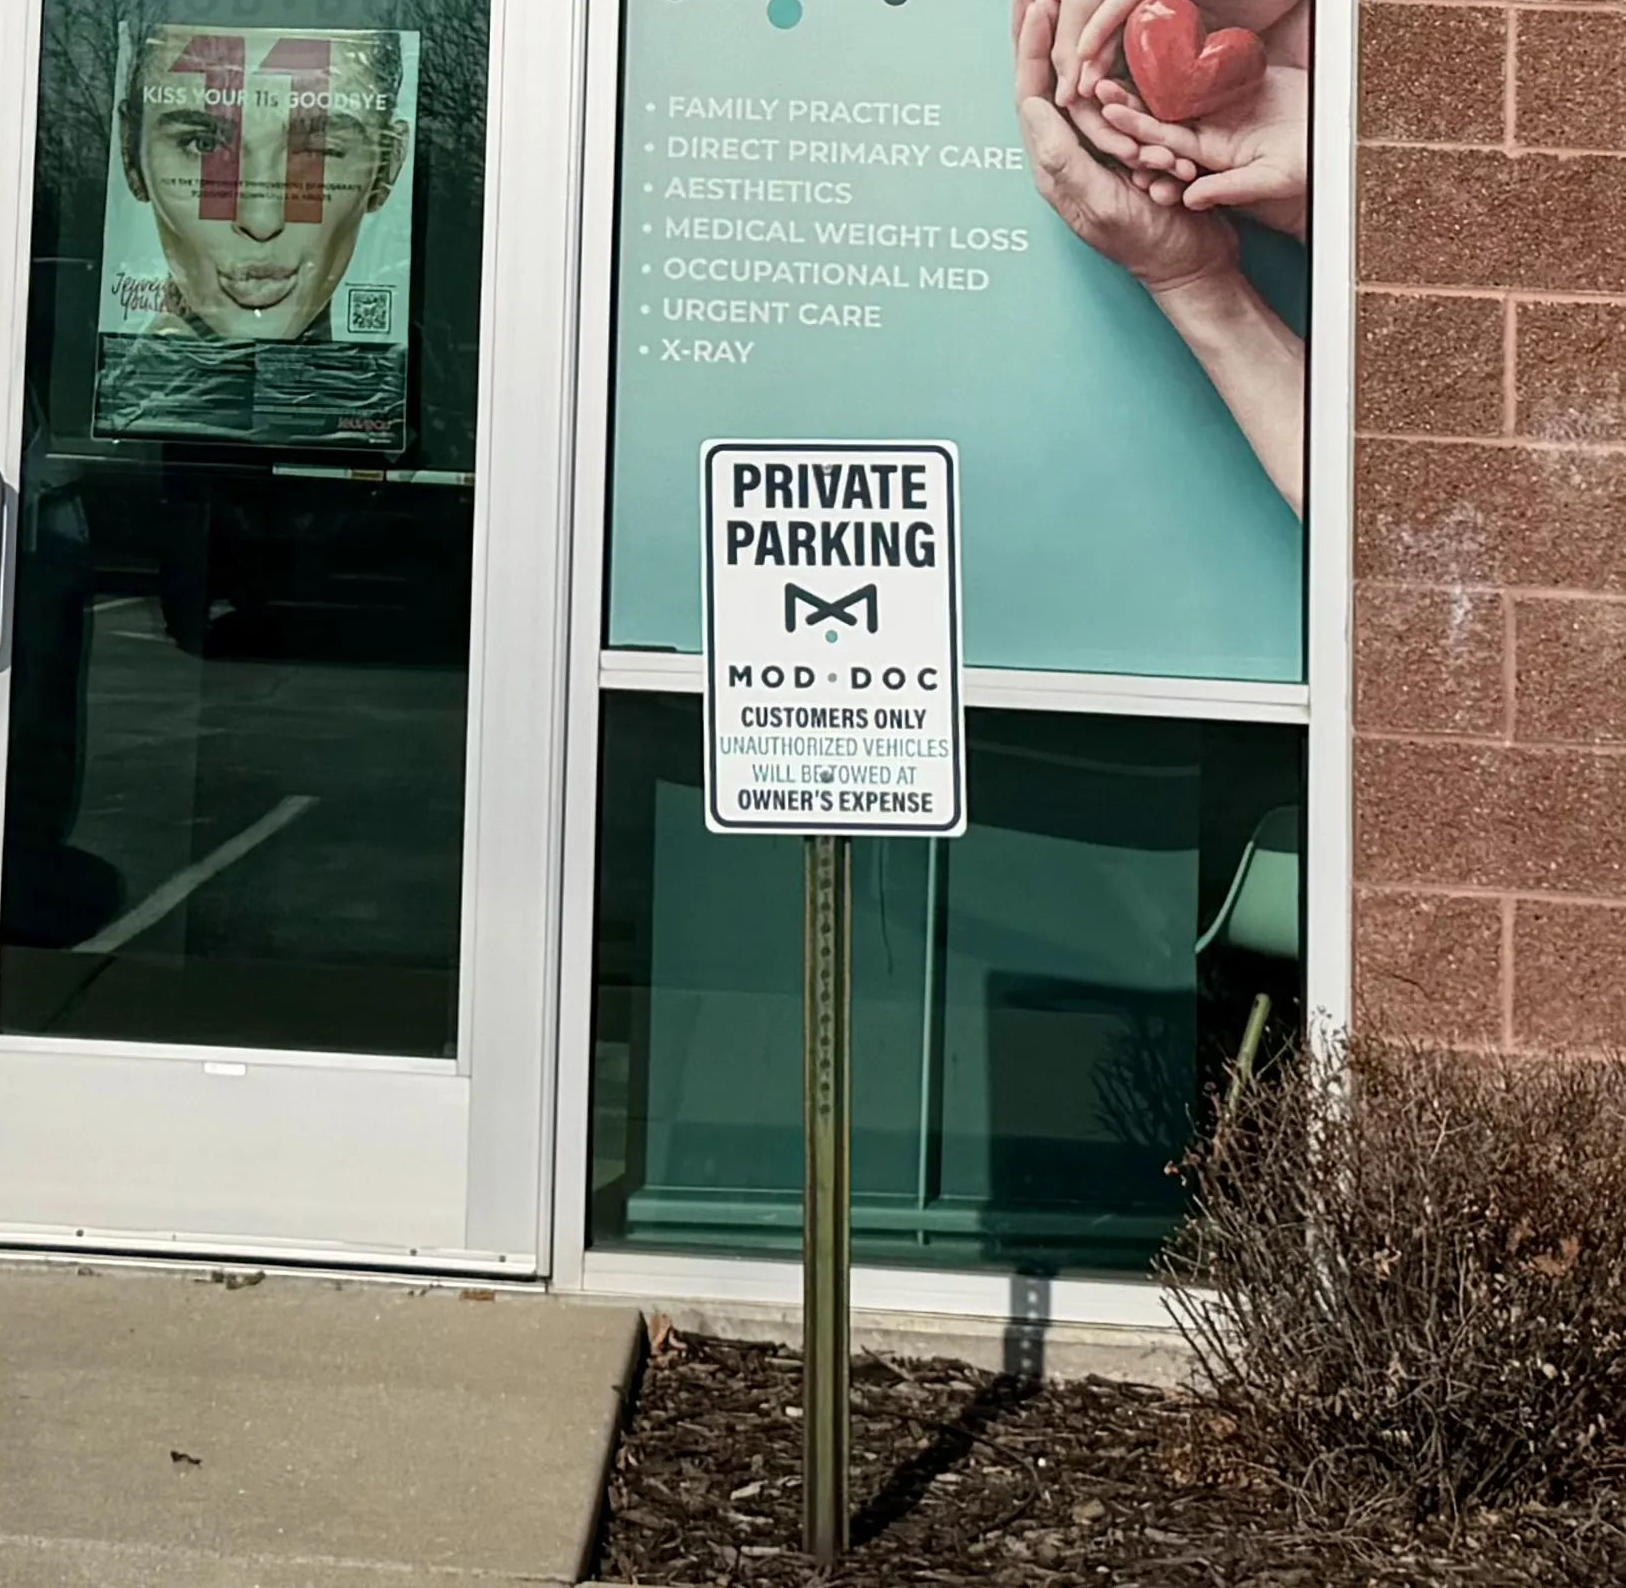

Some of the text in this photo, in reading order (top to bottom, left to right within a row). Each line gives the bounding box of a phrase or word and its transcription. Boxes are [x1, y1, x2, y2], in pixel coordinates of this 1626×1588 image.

[143, 86, 186, 106] KISS
[194, 87, 247, 108] YOUR
[287, 89, 387, 111] GOODBYE
[669, 96, 942, 126] FAMILY PRACTICE
[668, 137, 1024, 170] DIRECT PRIMARY CARE
[664, 177, 854, 205] AESTHETICS
[665, 217, 1029, 252] MEDICAL WEIGHT LOSS
[663, 257, 990, 291] OCCUPATIONAL MED
[663, 298, 882, 328] URGENT CARE
[660, 339, 755, 364] X-RAY
[733, 463, 928, 509] PRIVATE
[726, 520, 936, 568] PARKING
[728, 665, 939, 691] MOD DOC
[741, 706, 927, 730] CUSTOMERS ONLY
[720, 736, 950, 758] UNAUTHORIZED VEHICLES
[752, 763, 917, 785] WILL BE TOWED AT
[737, 789, 934, 813] OWNER'S EXPENSE
